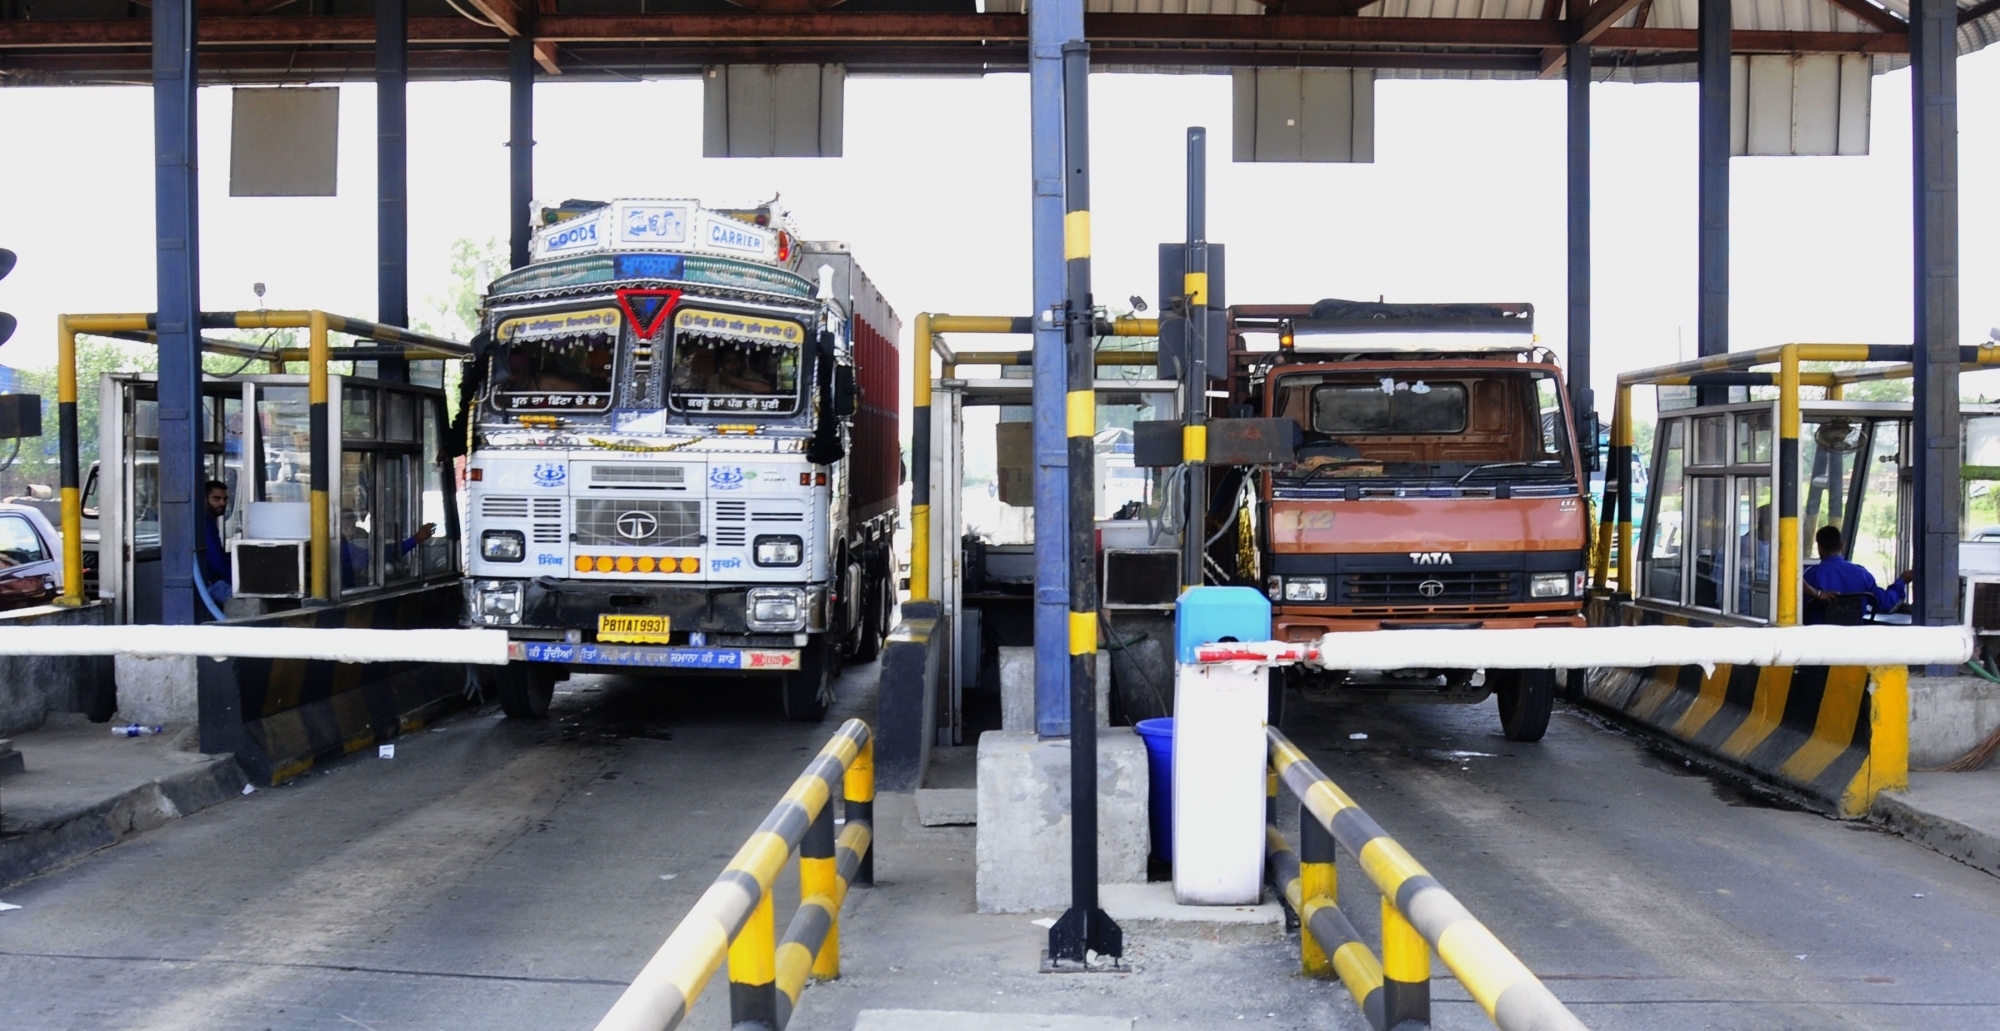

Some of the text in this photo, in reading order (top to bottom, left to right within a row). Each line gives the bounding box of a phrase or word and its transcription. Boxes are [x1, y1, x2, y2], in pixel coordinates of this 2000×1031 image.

[548, 222, 597, 247] GOODS
[713, 225, 760, 248] CARRIER
[531, 396, 545, 406] ਦਾ
[575, 395, 585, 406] ਦੇ
[746, 398, 758, 409] ਦੀ
[1409, 552, 1453, 566] TATA
[602, 619, 666, 633] PB11AT9931
[528, 646, 541, 659] ਕੀ
[701, 651, 714, 664] ਕੀ
